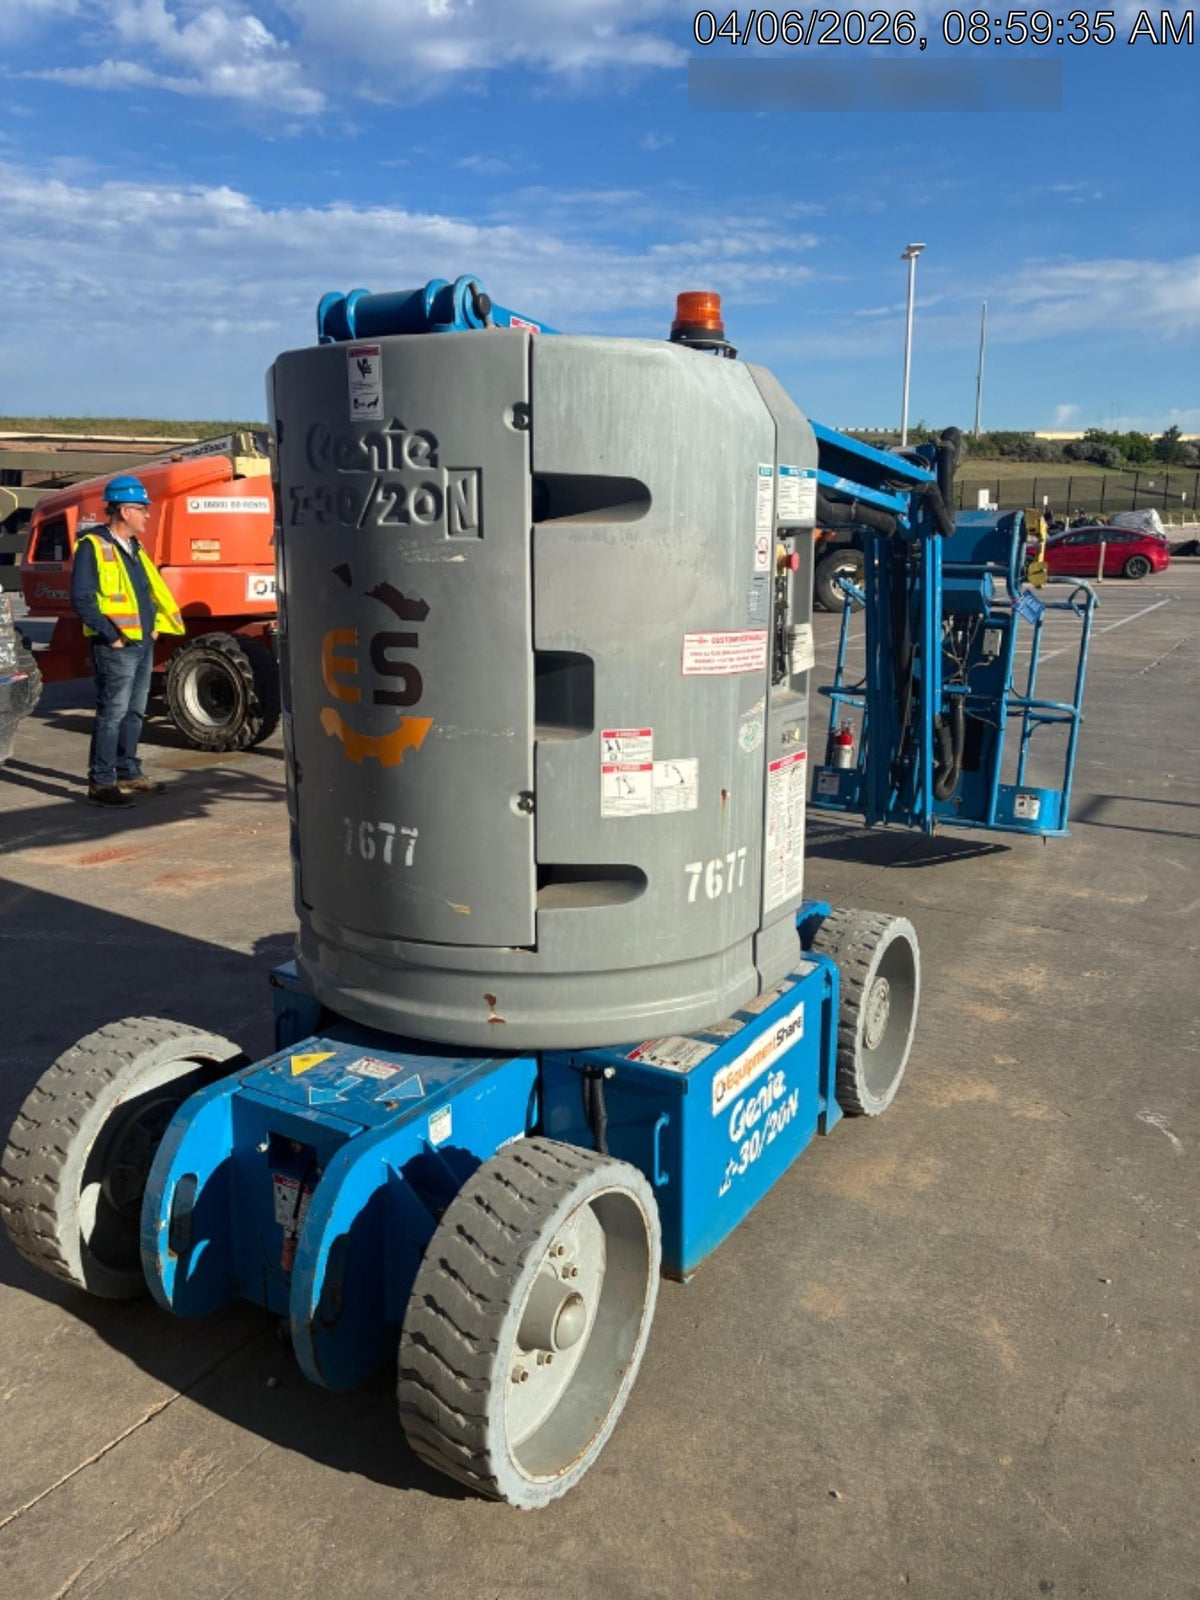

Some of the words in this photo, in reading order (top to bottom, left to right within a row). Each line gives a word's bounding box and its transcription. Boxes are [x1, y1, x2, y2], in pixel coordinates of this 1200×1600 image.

[306, 417, 439, 473] Genie
[321, 628, 424, 706] ES
[684, 848, 747, 902] 7677
[725, 1016, 803, 1089] EquipmentShare
[729, 1070, 786, 1143] Genie
